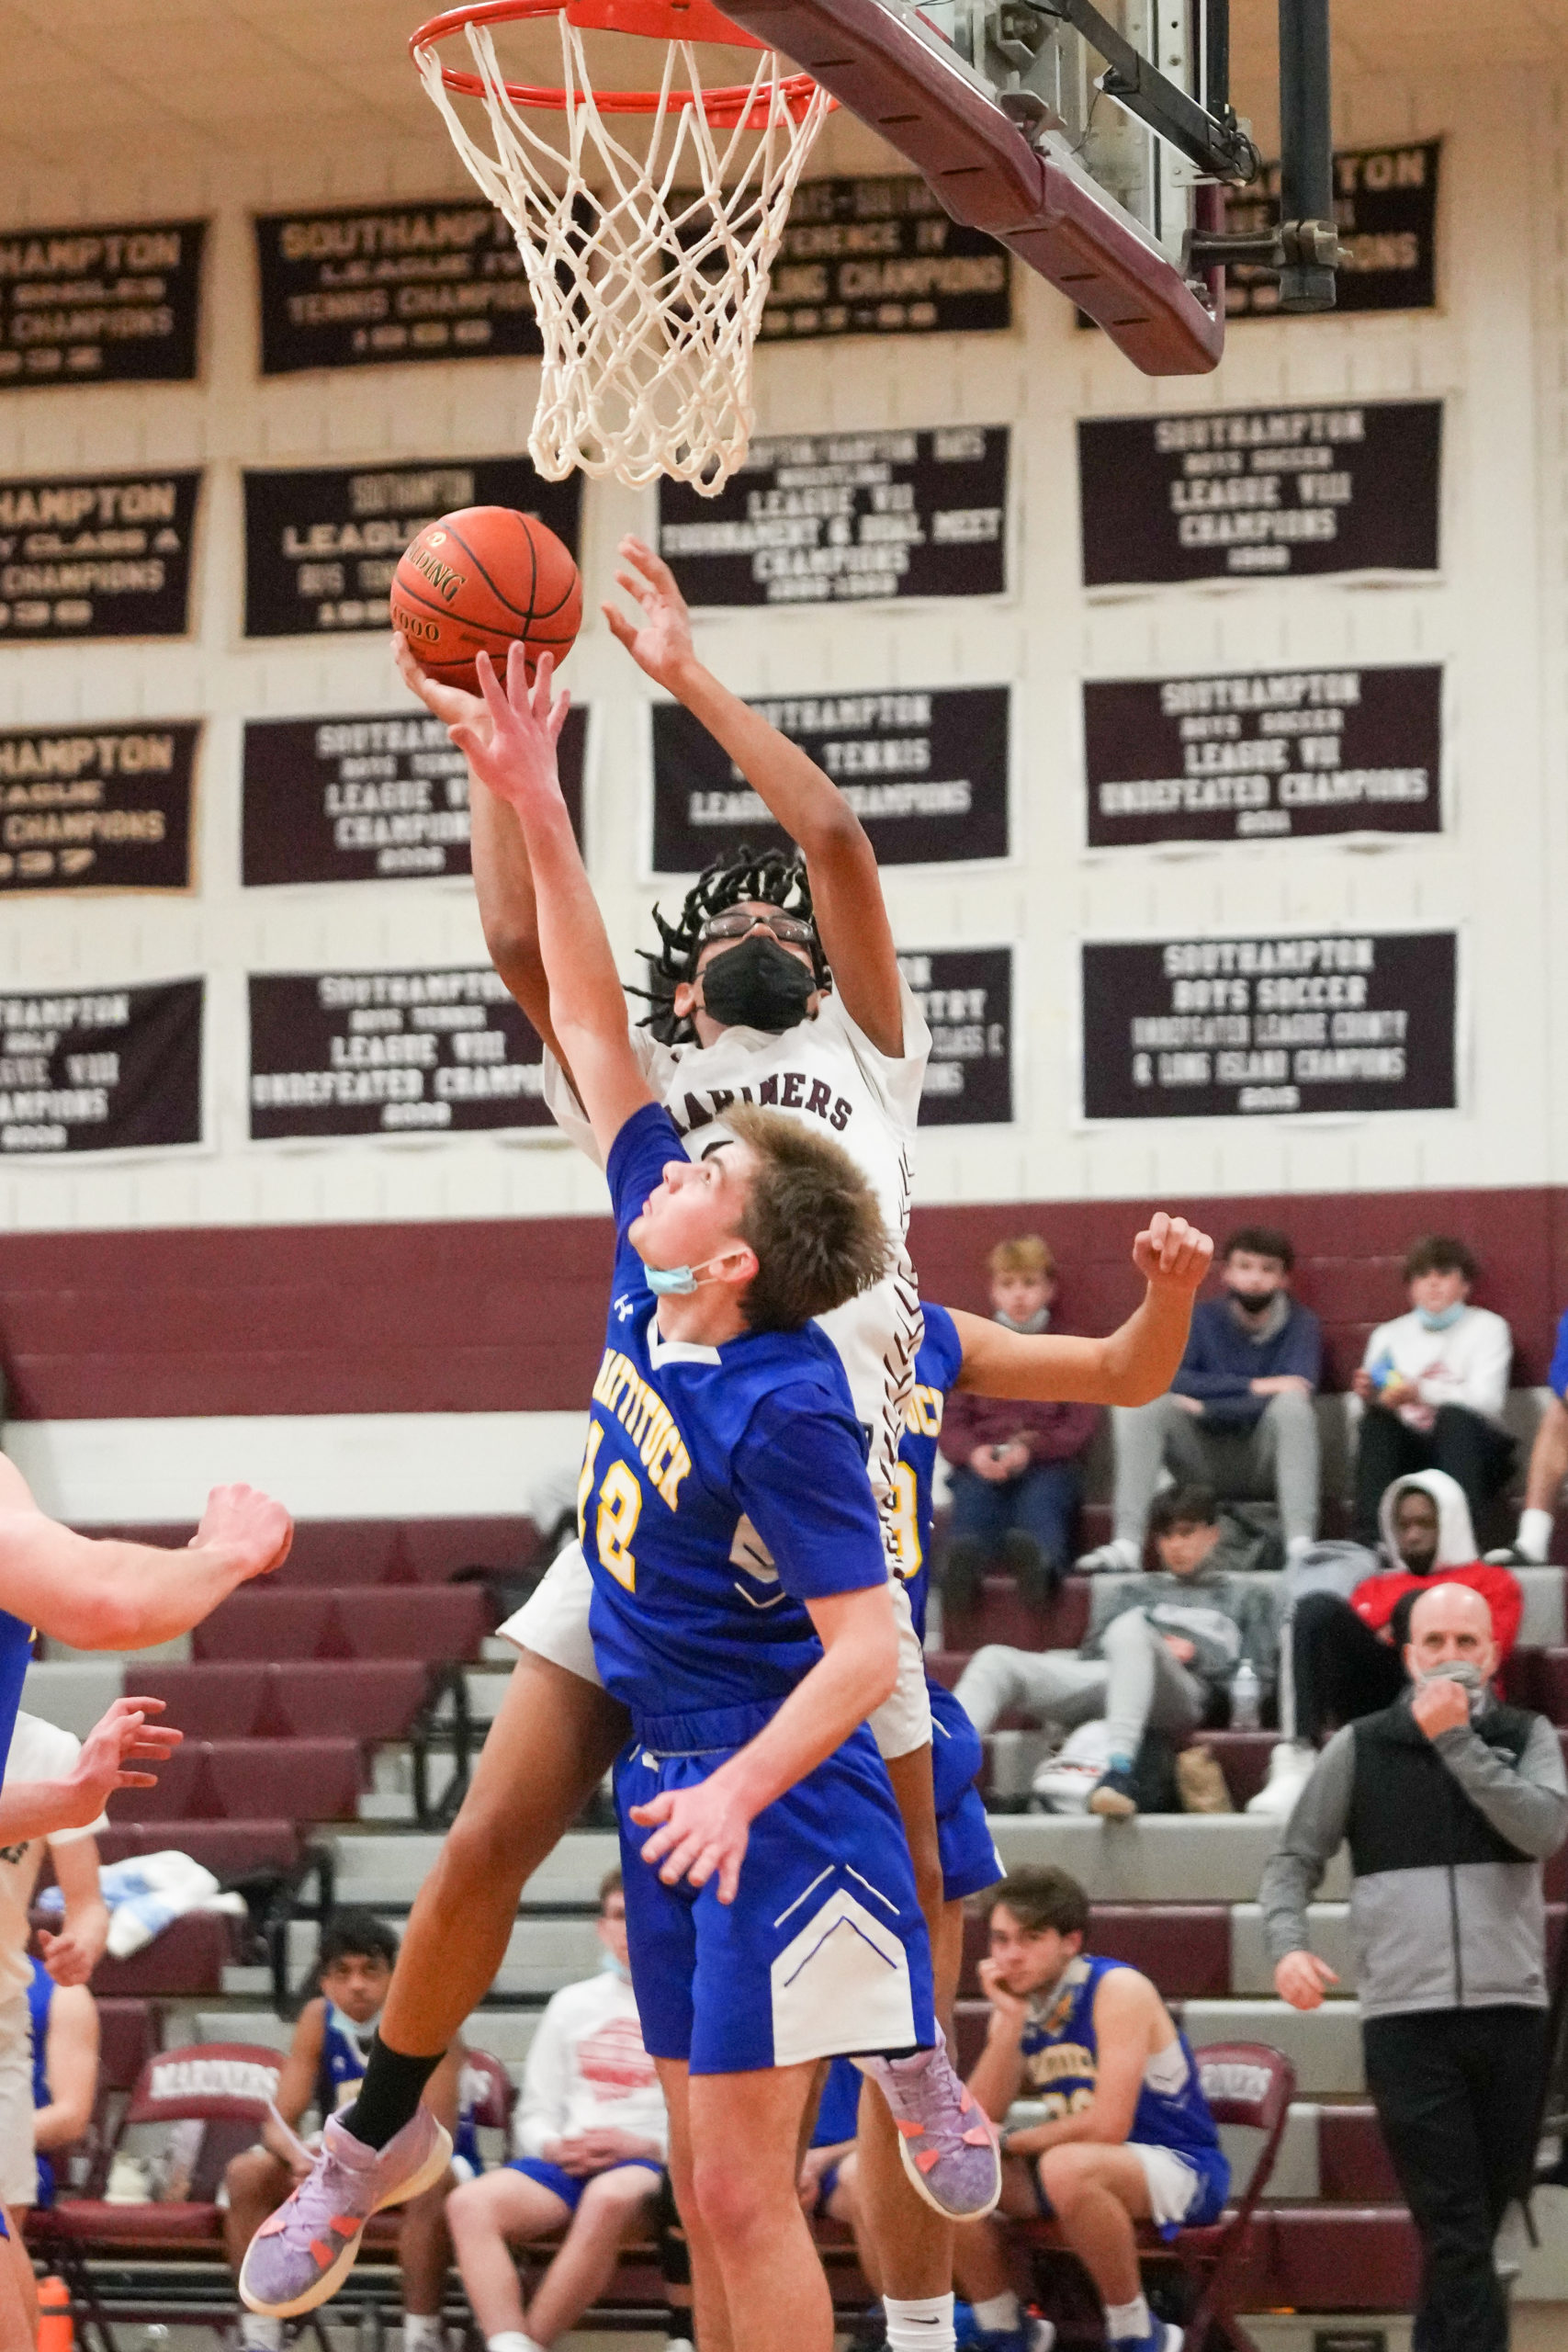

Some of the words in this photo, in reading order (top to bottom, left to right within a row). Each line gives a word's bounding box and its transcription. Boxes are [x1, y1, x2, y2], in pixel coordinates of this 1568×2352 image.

[1155, 411, 1367, 453] SOUTHAMPTON
[1170, 474, 1281, 514] LEAGUE
[1179, 507, 1337, 548] CHAMPIONS
[1161, 671, 1361, 717] SOUTHAMPTON
[1184, 738, 1290, 775] LEAGUE
[1278, 766, 1429, 808] CHAMPIONS
[1162, 938, 1375, 978] SOUTHAMPTON
[1171, 978, 1250, 1014] BOYS
[1256, 975, 1369, 1012] SOCCER
[330, 1032, 439, 1069] LEAGUE
[1292, 1046, 1408, 1082] CHAMPIONS
